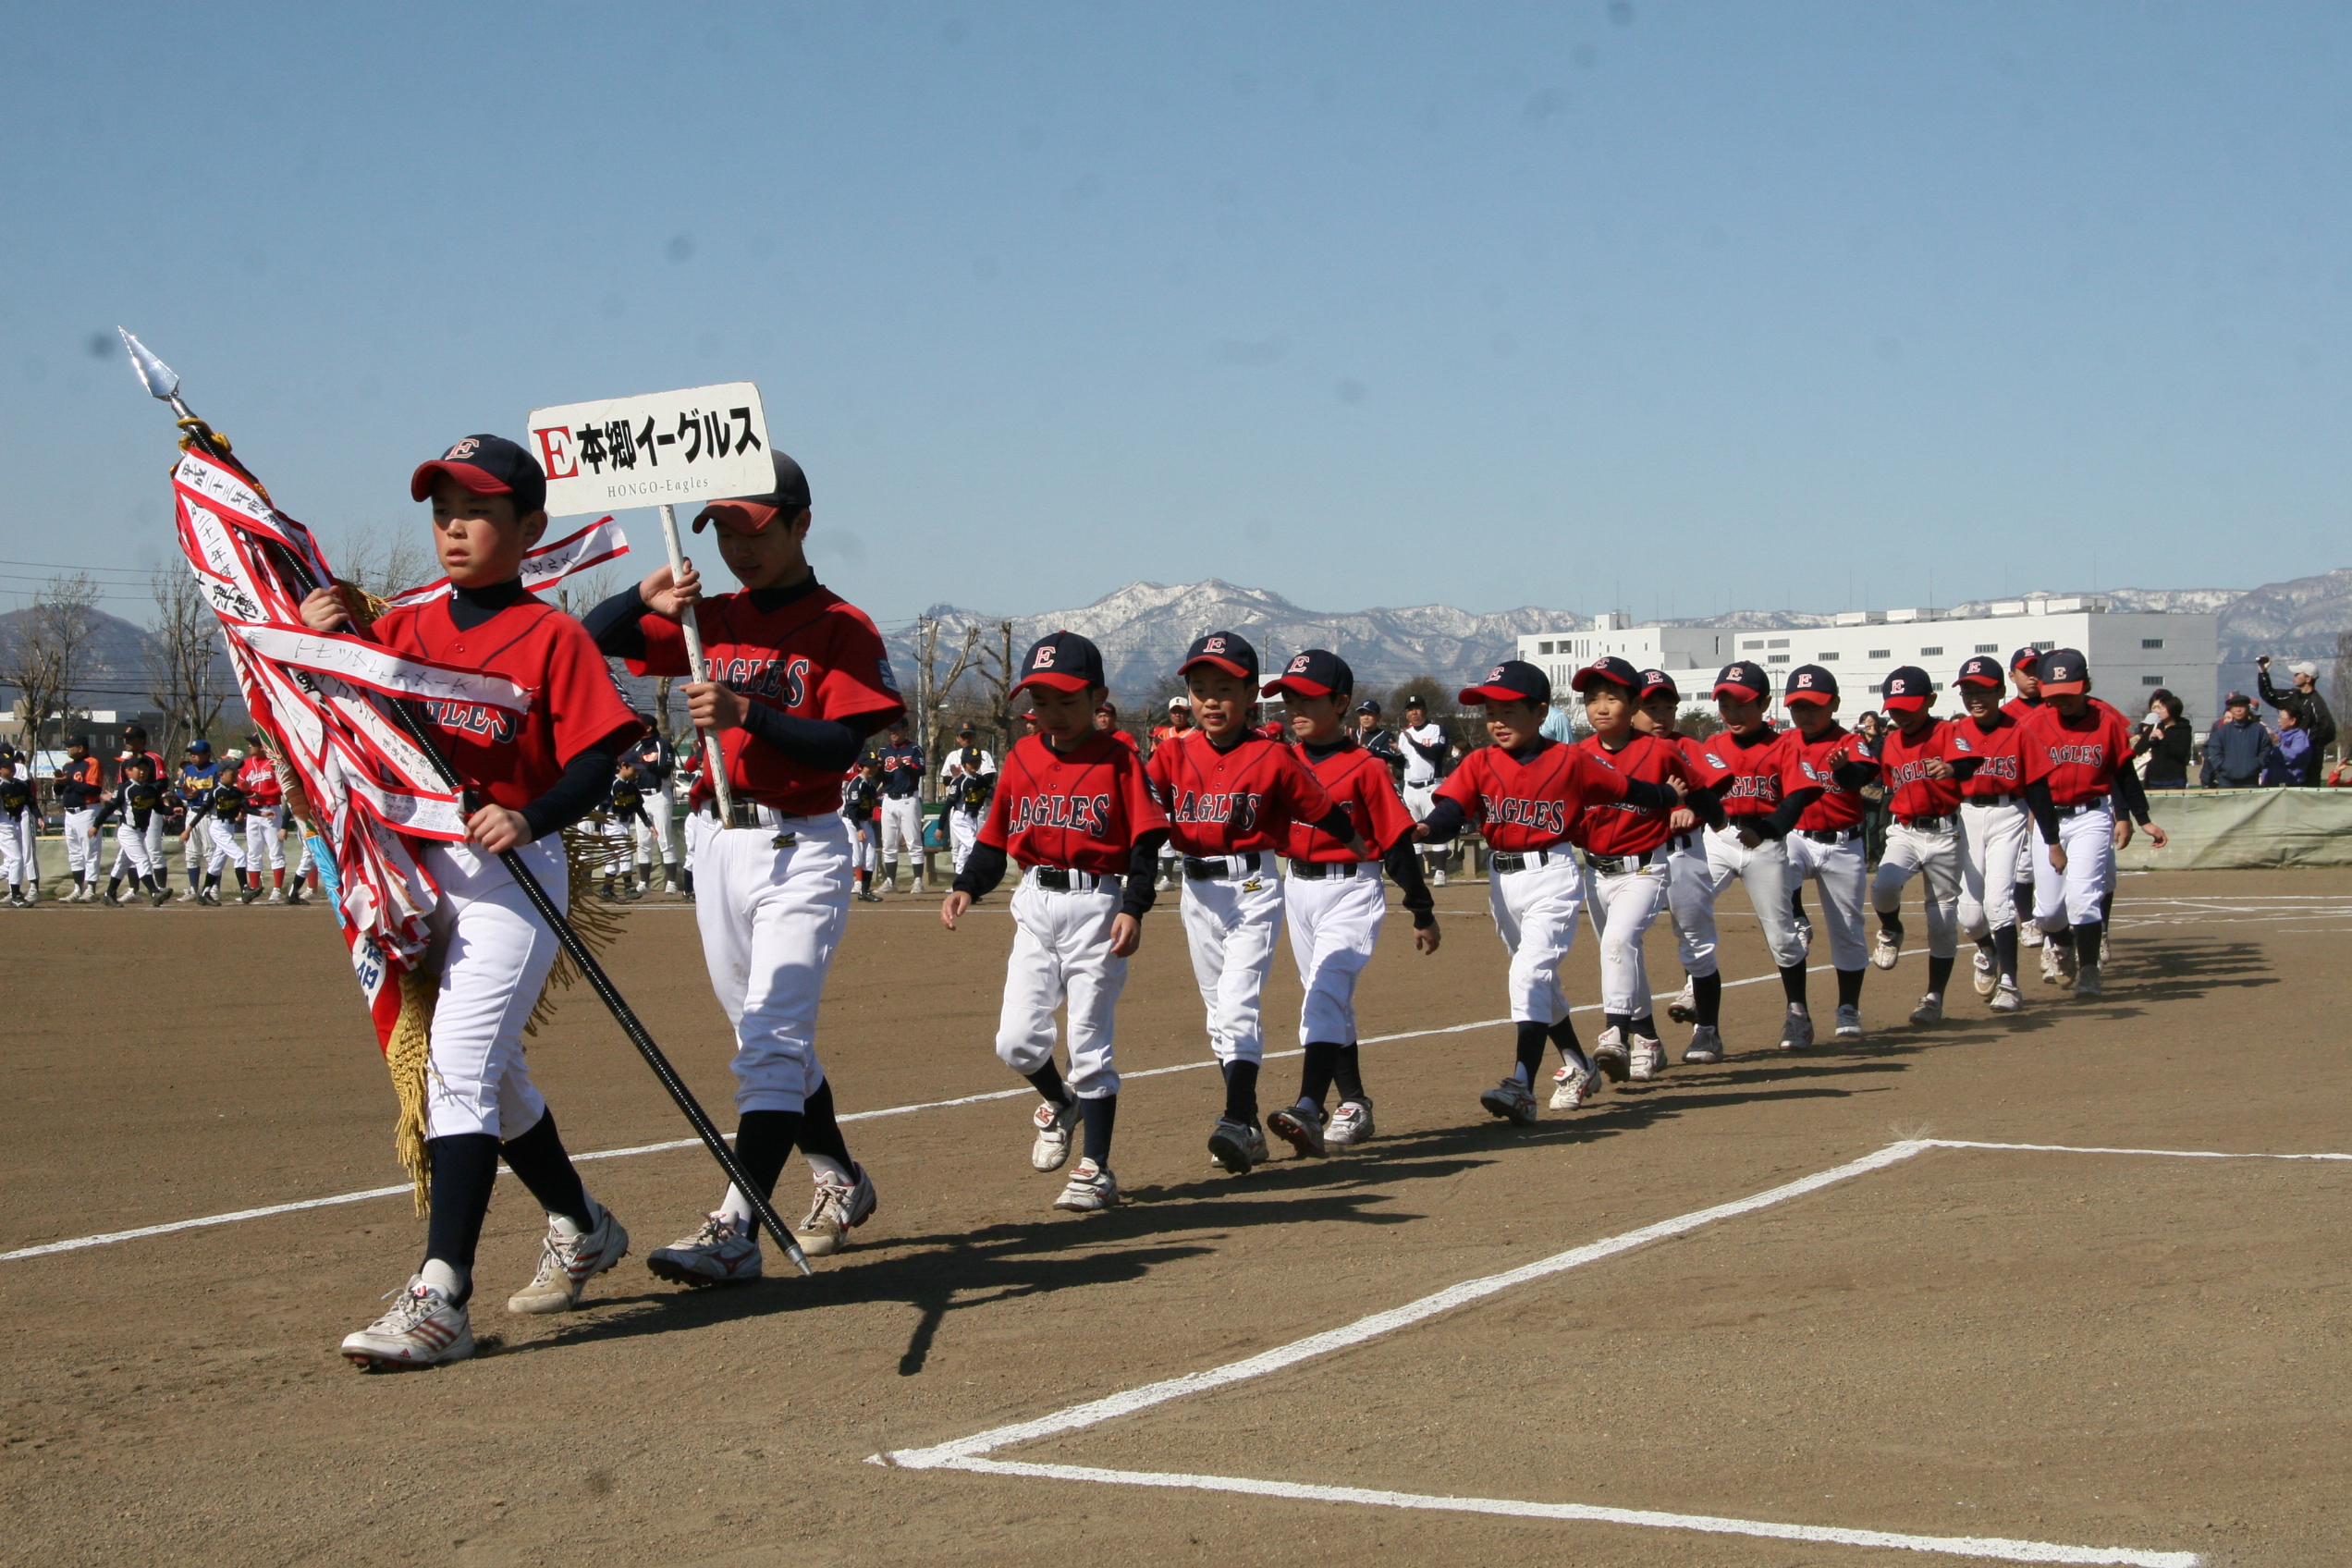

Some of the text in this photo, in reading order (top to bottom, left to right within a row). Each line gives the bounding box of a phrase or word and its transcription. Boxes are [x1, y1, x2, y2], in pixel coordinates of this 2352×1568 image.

[446, 438, 480, 459] E
[533, 406, 762, 480] E 本郷イーグルス
[606, 477, 709, 498] HONGO-Eagles
[1203, 638, 1226, 654] E
[1032, 646, 1056, 669] E
[1288, 655, 1310, 673] E
[1485, 666, 1505, 682] E
[1726, 667, 1744, 682] E
[1966, 661, 1981, 674] E
[2052, 667, 2067, 680] E
[1645, 671, 1664, 684] E
[1796, 673, 1813, 688] E
[1890, 679, 1905, 695] E
[2044, 744, 2102, 767] AGLES
